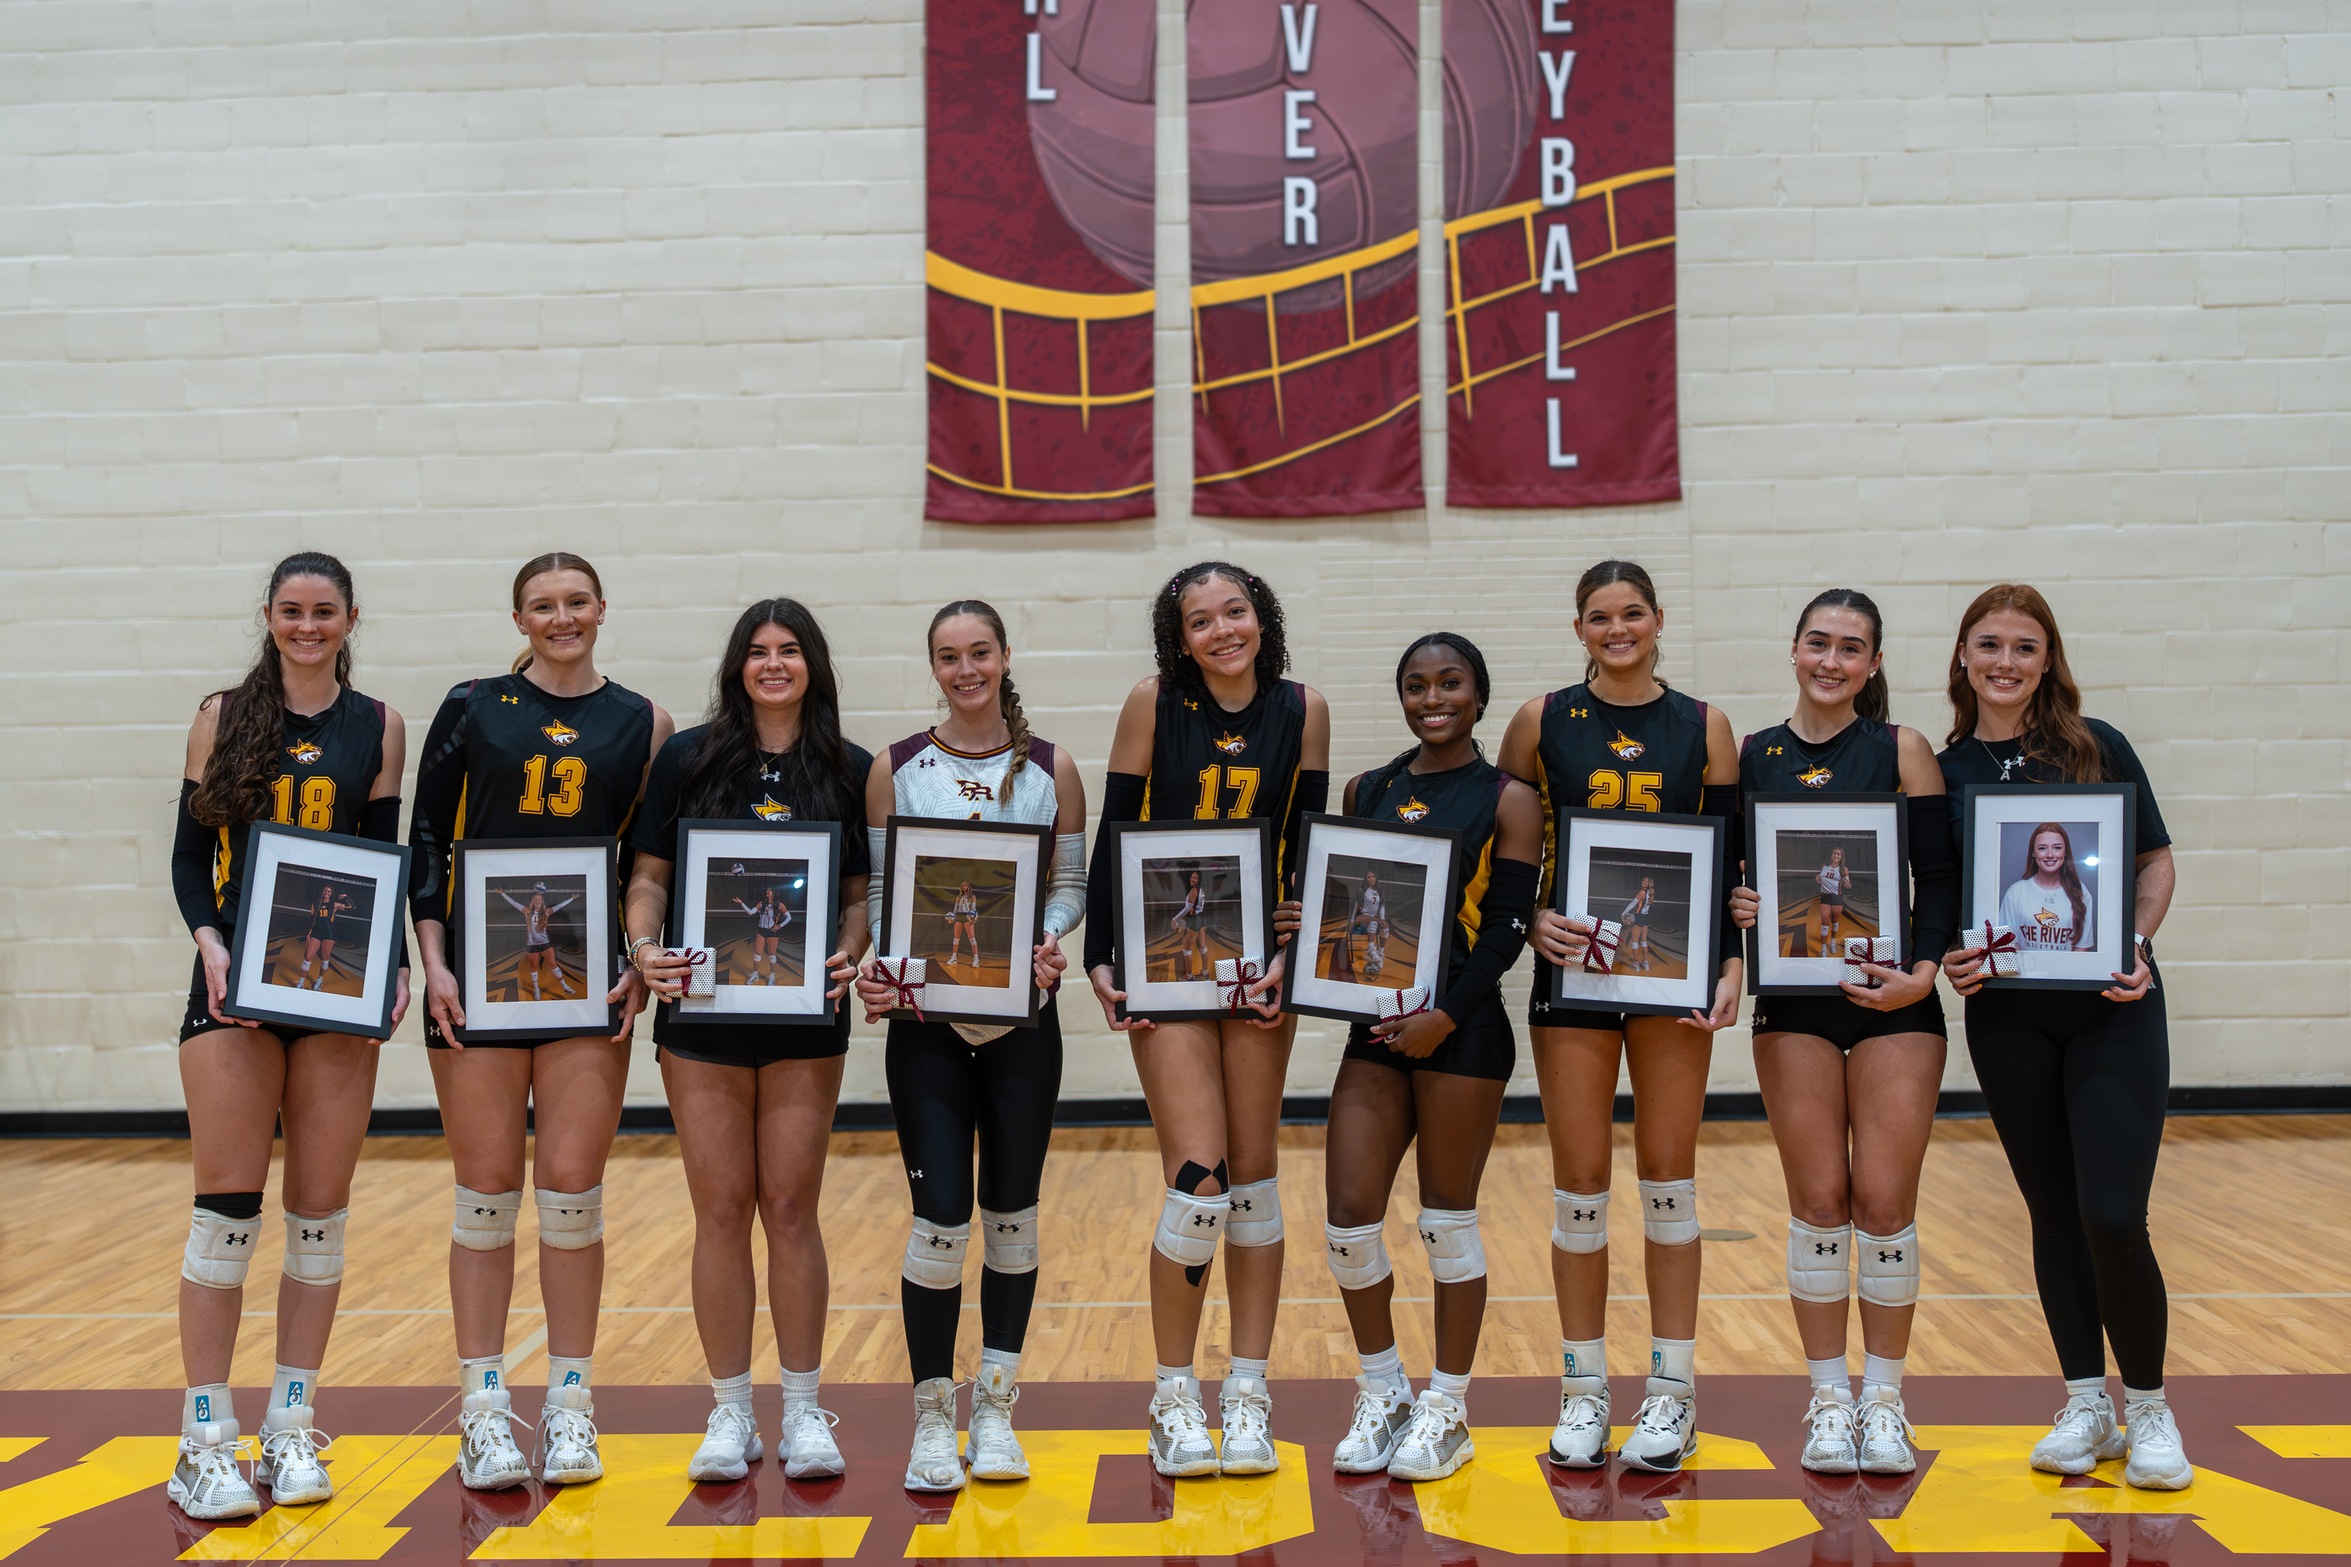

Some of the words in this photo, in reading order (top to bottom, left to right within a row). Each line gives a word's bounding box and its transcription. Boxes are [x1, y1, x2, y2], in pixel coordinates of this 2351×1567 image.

[1023, 0, 1060, 100] L
[1280, 3, 1318, 245] VER
[270, 774, 336, 832] 18
[518, 754, 587, 817] 13
[1193, 763, 1260, 820] 17
[1587, 769, 1662, 813] 25
